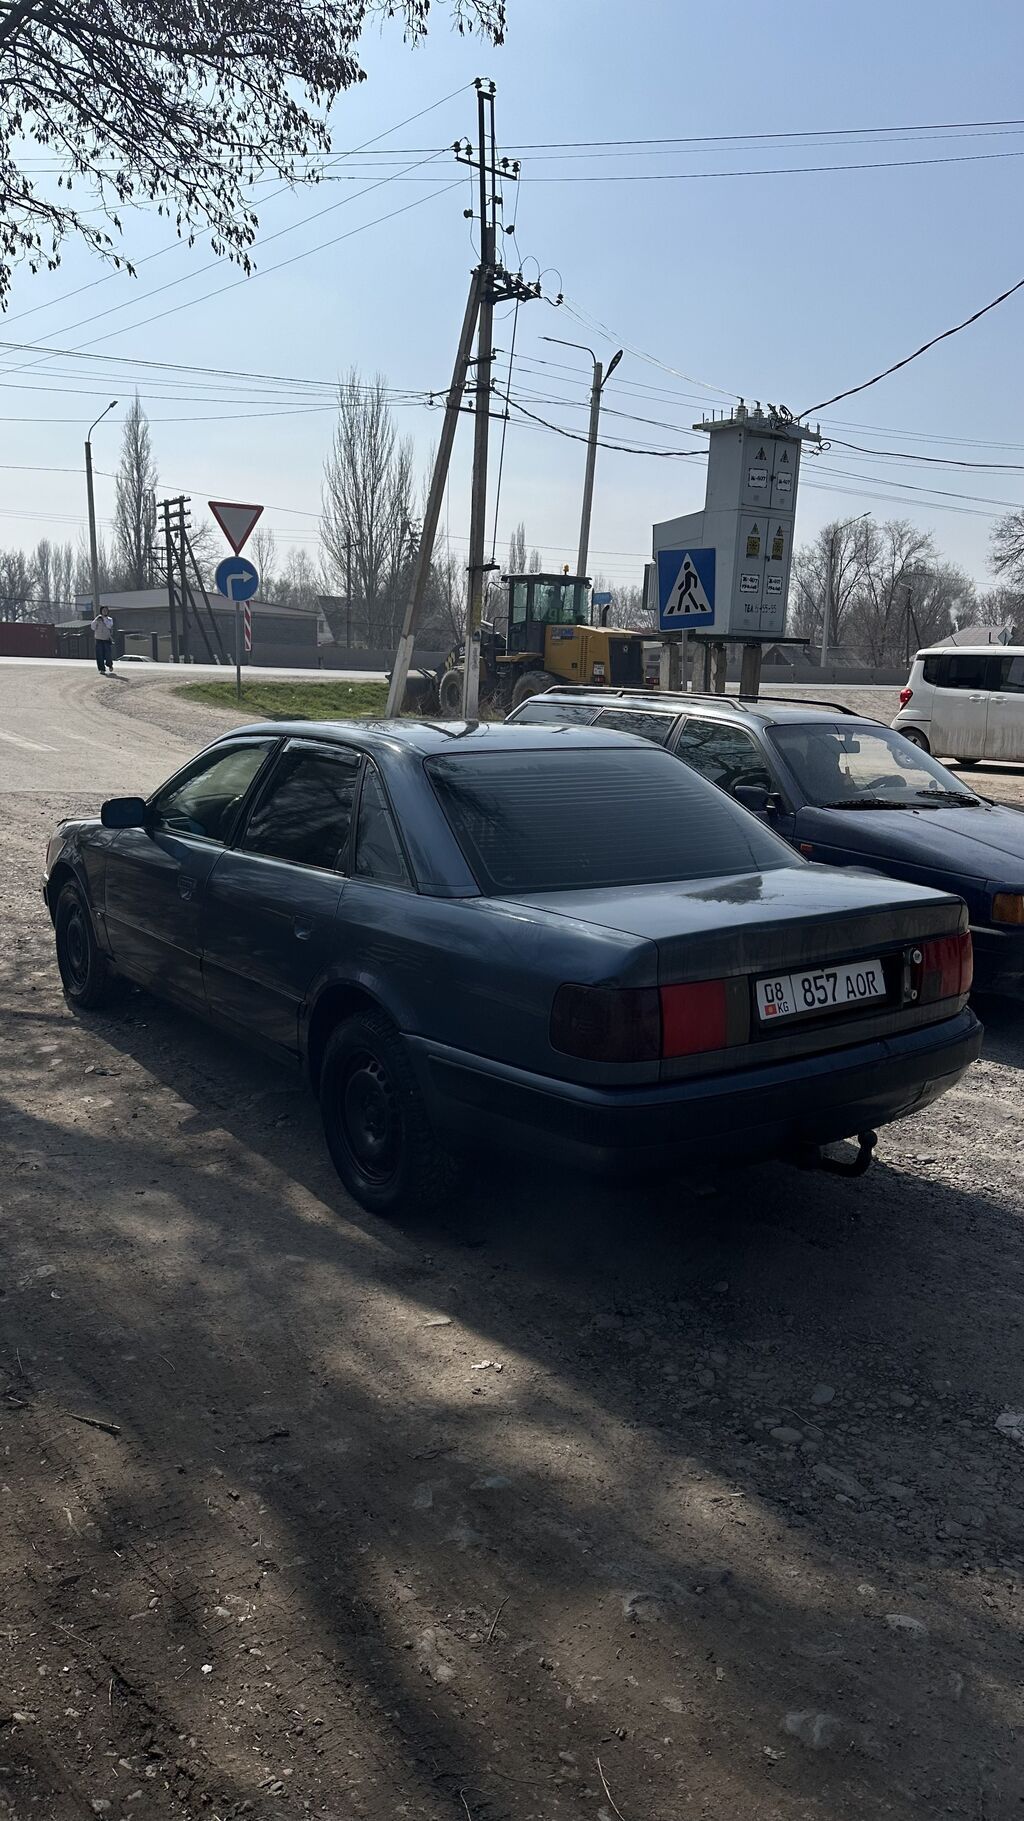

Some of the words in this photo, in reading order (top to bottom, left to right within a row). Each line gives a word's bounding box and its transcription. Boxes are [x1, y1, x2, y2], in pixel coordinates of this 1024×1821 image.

[764, 982, 784, 1003] 08
[801, 972, 838, 1007] 857
[846, 970, 879, 999] AOR
[778, 1002, 789, 1013] KG
